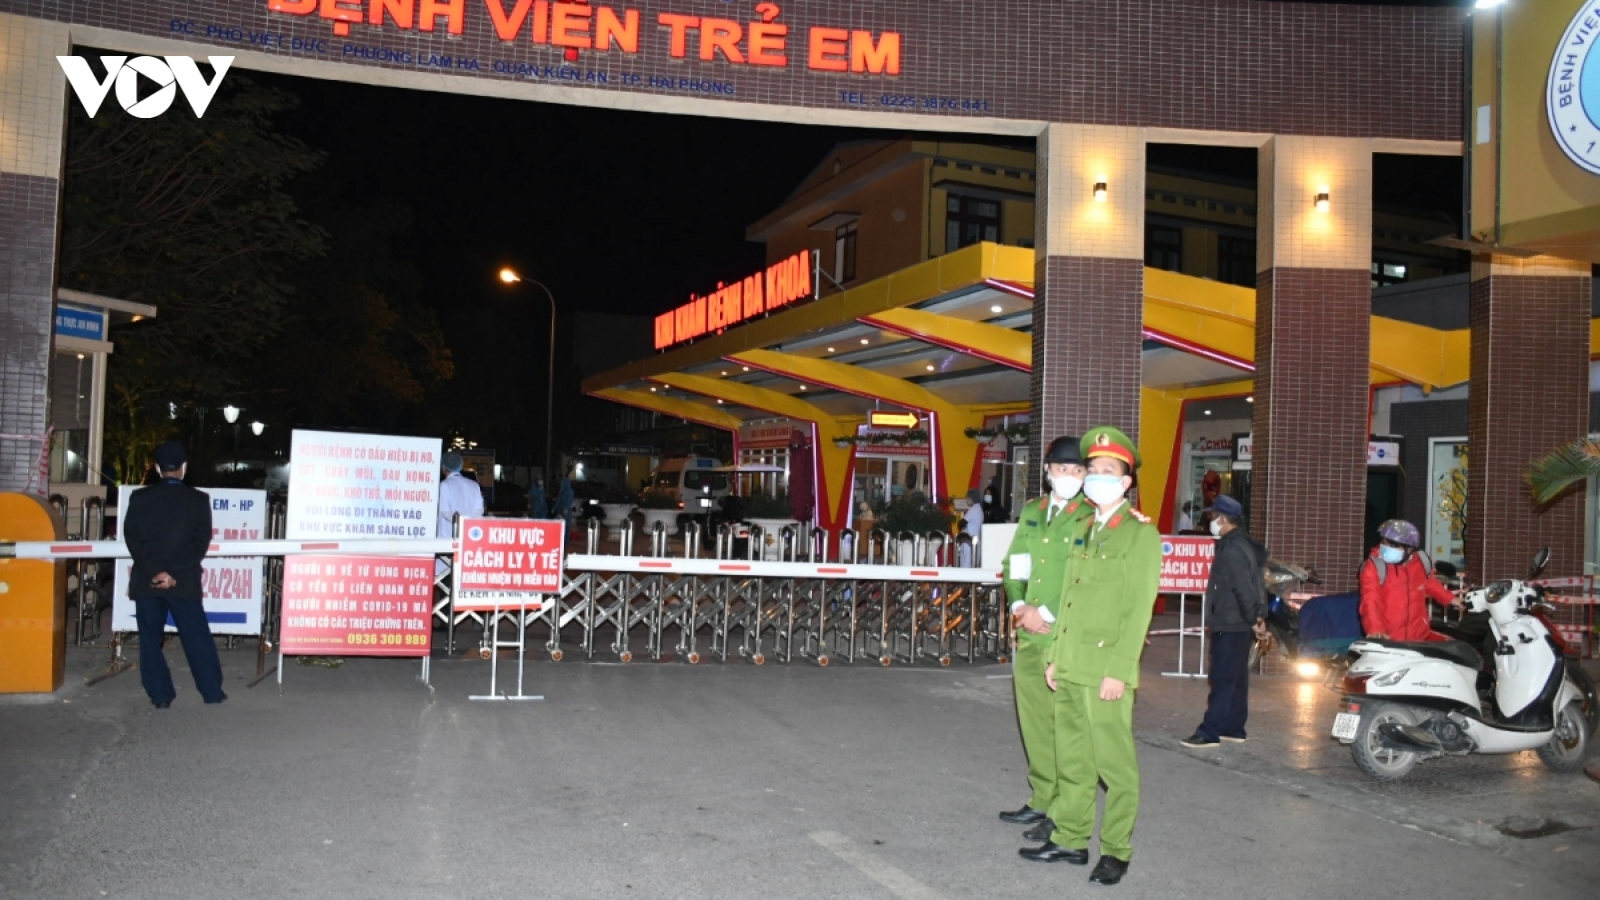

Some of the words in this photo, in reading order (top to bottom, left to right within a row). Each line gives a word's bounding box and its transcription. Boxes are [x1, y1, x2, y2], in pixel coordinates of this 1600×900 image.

[659, 2, 788, 67] TRẺ
[808, 27, 901, 76] EM
[585, 70, 608, 84] AN
[766, 249, 812, 310] KHOA
[212, 499, 229, 511] EM
[240, 500, 254, 512] HP
[407, 525, 426, 538] LỌC
[488, 527, 517, 545] KHU
[519, 527, 545, 549] VỰC
[1175, 543, 1197, 557] KHU
[463, 546, 505, 568] CÁCH
[507, 551, 525, 569] LY
[528, 551, 538, 569] Y
[541, 547, 560, 570] TẾ
[1191, 562, 1204, 576] LY
[378, 584, 404, 596] QUAN
[362, 600, 408, 613] COVID-19
[347, 632, 378, 645] 0936
[380, 634, 402, 646] 300
[405, 634, 428, 646] 989
